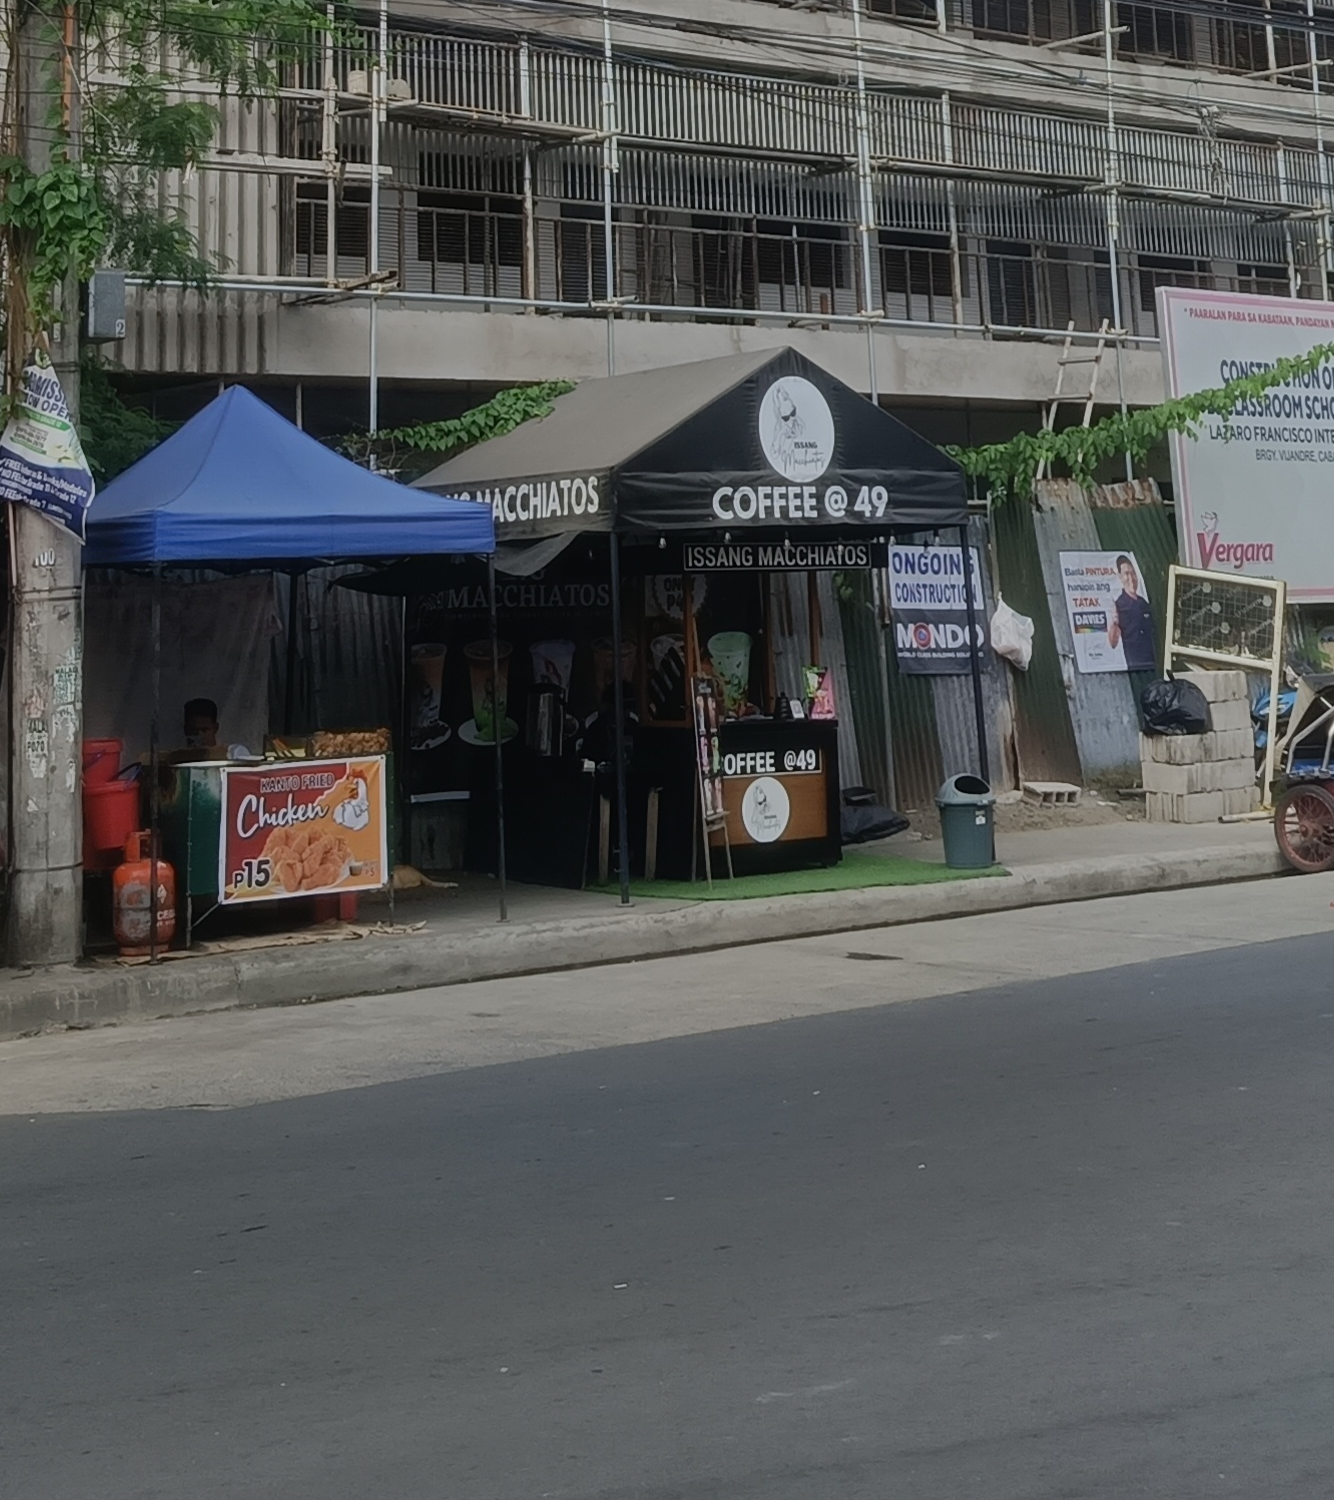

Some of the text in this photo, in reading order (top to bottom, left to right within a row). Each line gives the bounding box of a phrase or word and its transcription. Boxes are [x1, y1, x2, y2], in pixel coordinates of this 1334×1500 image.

[117, 322, 125, 335] 2
[1227, 391, 1304, 419] LASSROOM
[794, 441, 818, 450] ISSANG
[1254, 426, 1313, 444] FRANCISCO
[712, 485, 888, 520] COFFEE @ 49
[688, 545, 867, 568] ISSANG MACCHIATOS
[1196, 532, 1274, 569] Vergara
[1085, 567, 1117, 577] PINTURA
[447, 583, 610, 610] MACCHIATOS
[1075, 614, 1106, 626] DAVIES
[896, 622, 985, 649] MONDO
[722, 749, 816, 775] OFFEE @49
[260, 772, 335, 794] KANTO FRIED
[237, 792, 330, 838] Chicken
